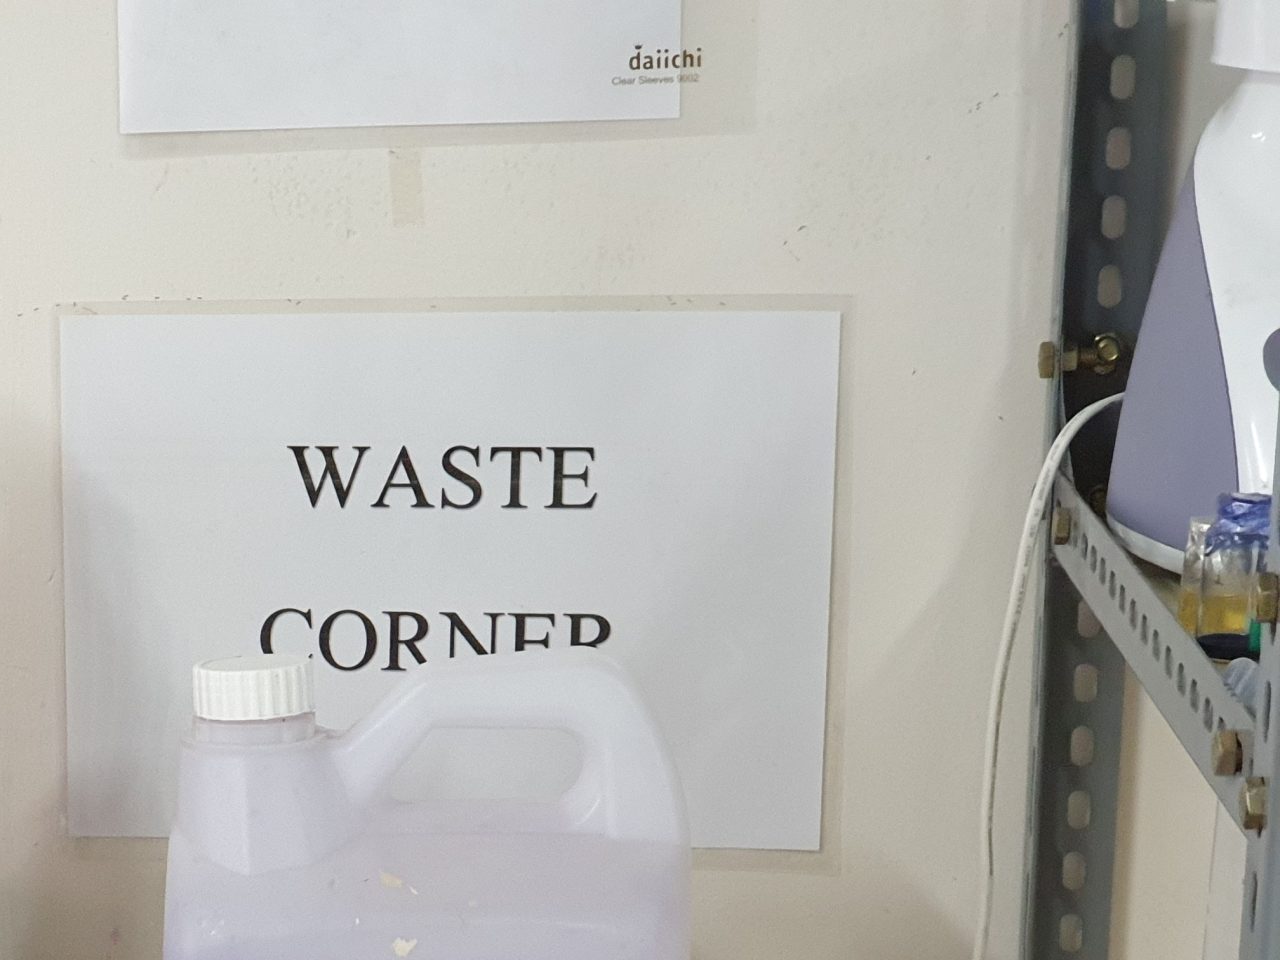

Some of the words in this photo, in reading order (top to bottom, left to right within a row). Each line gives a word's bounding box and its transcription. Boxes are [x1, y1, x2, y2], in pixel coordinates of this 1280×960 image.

[628, 45, 702, 70] daiichi
[611, 76, 635, 86] Clear
[287, 445, 598, 510] WASTE
[260, 608, 612, 671] CORNER
